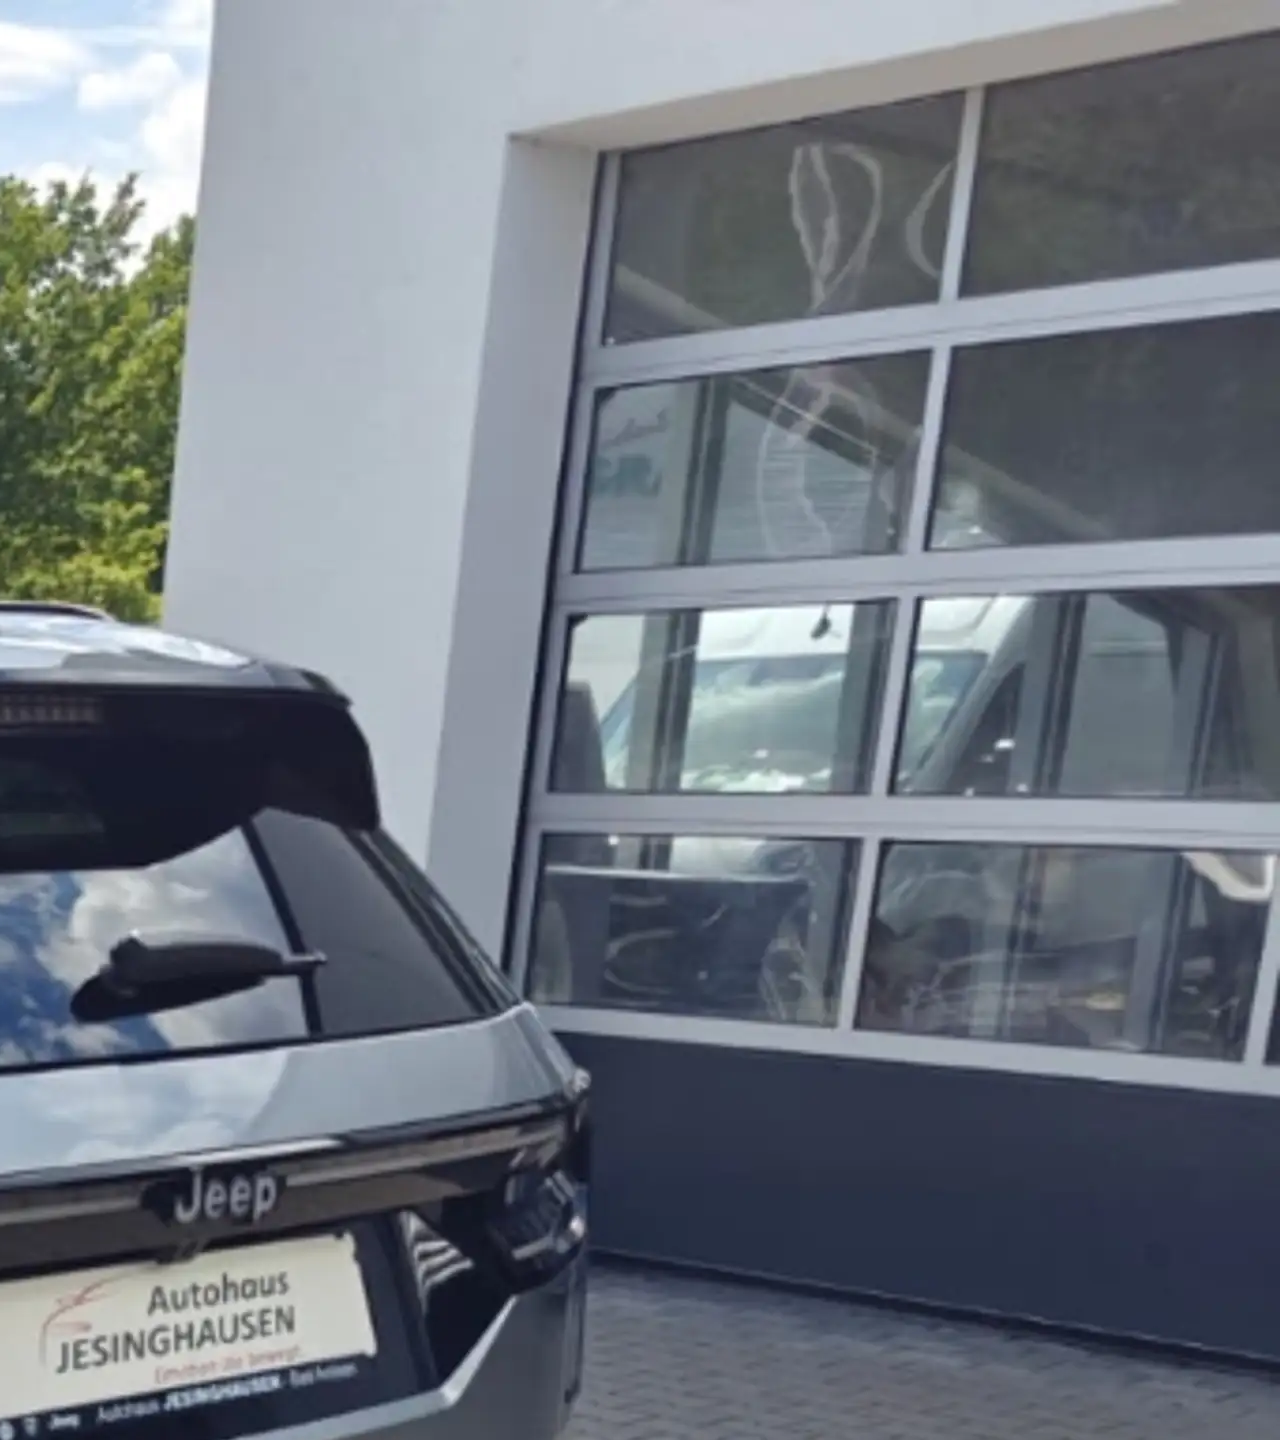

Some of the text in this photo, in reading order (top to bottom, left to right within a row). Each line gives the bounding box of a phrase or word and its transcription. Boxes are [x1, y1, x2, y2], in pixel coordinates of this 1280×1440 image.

[174, 1163, 278, 1223] Jeep
[146, 1270, 290, 1316] Autohaus
[54, 1304, 296, 1374] JESINGHAUSEN
